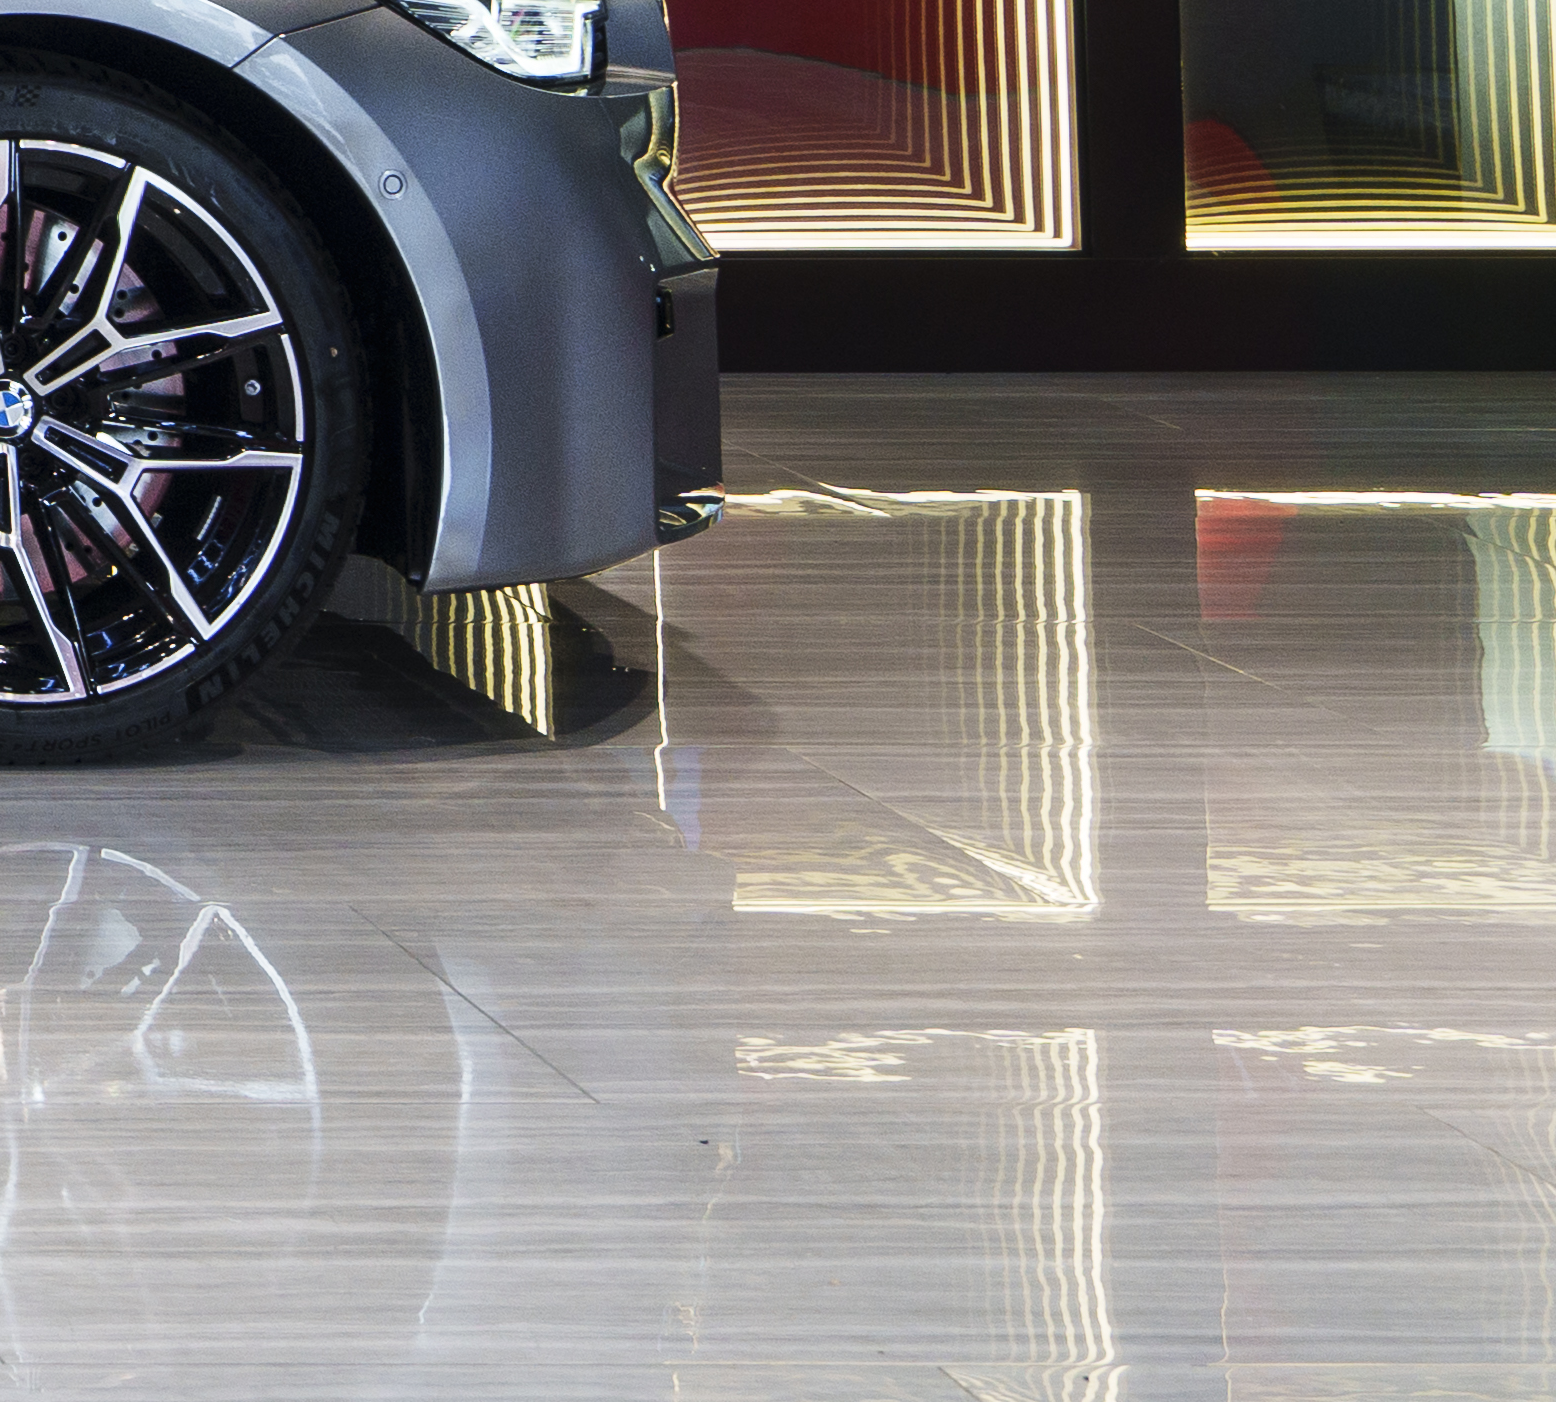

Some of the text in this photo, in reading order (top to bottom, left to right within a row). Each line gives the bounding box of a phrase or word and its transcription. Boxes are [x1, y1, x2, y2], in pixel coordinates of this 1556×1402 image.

[193, 509, 341, 704] MICHELIN
[26, 732, 103, 752] SPORT
[115, 711, 173, 742] PILOT
